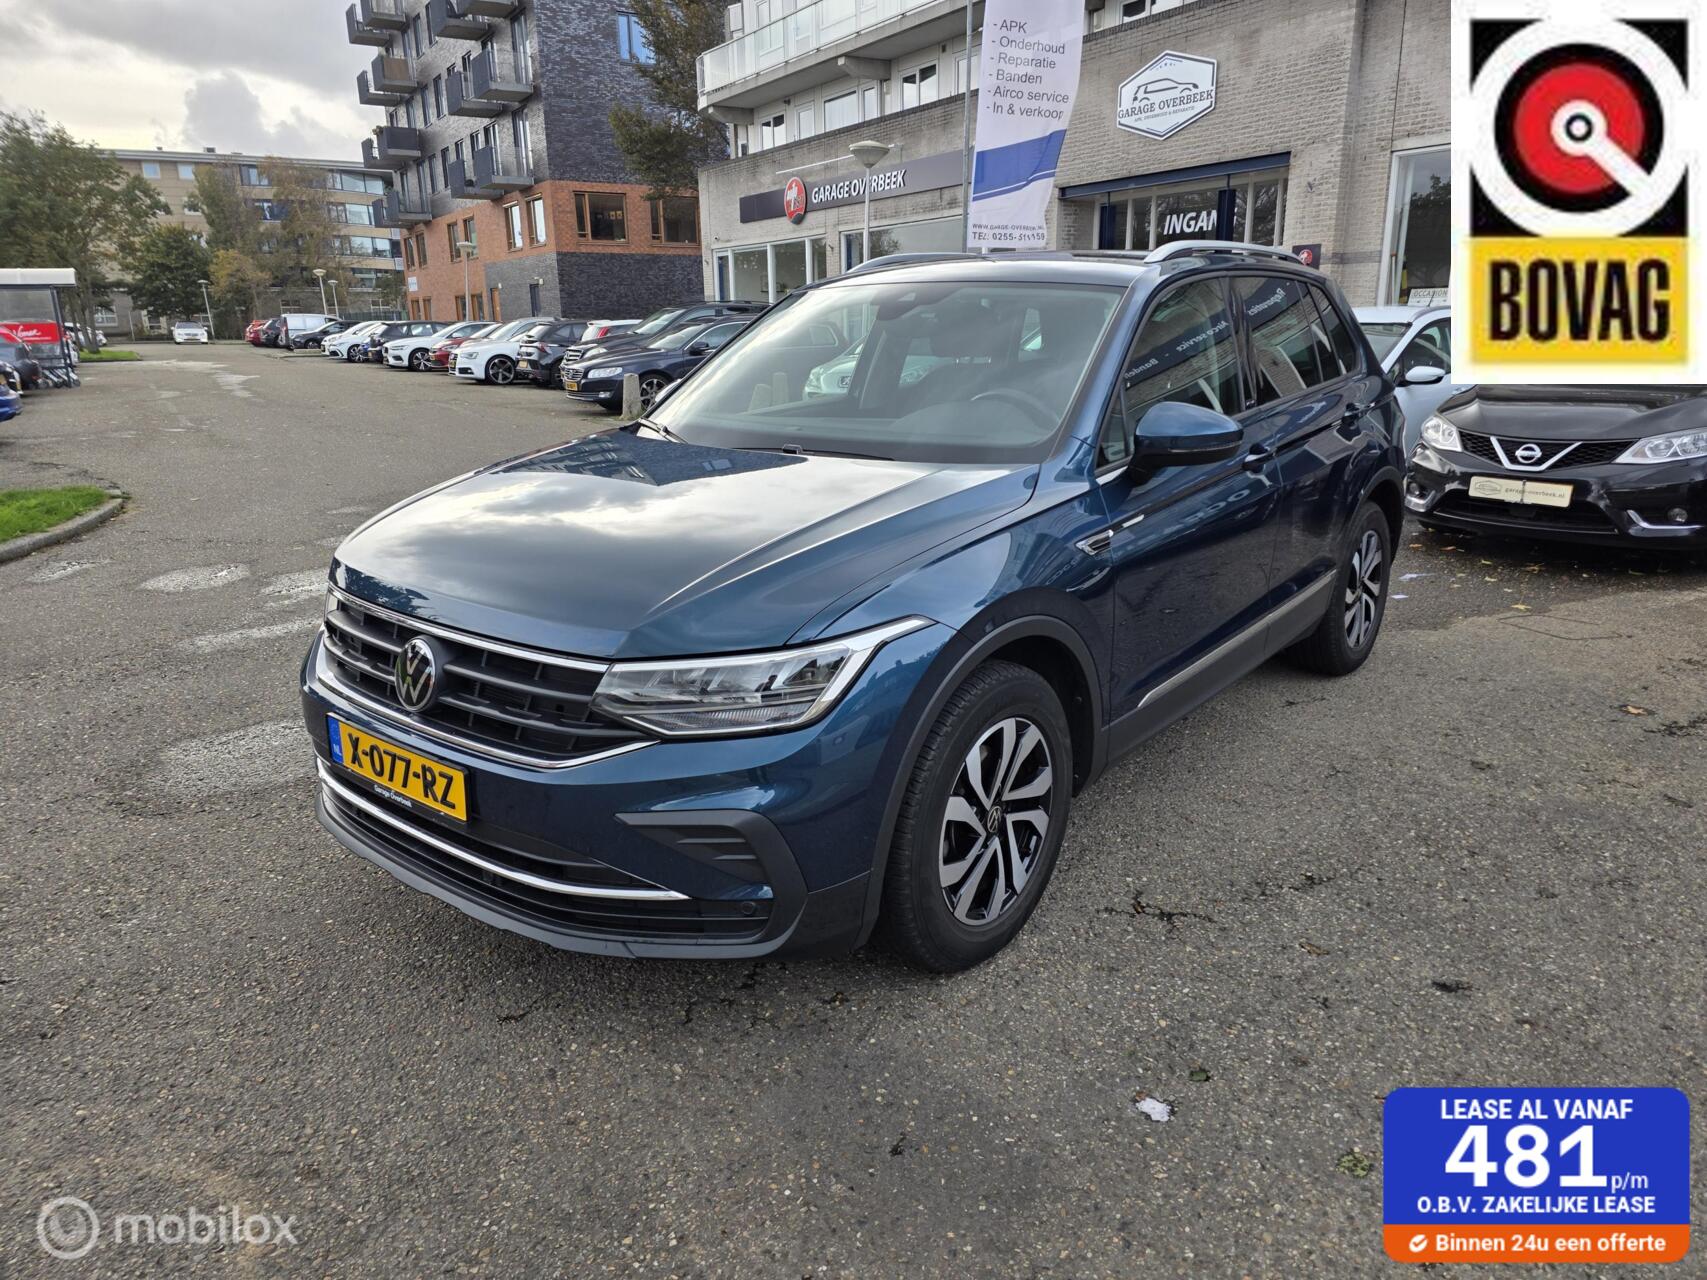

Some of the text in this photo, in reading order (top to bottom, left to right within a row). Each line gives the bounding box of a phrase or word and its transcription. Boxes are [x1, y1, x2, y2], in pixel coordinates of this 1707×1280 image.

[1000, 19, 1027, 34] APK
[1000, 36, 1065, 54] Onderhoud
[998, 52, 1056, 69] Reparatie
[996, 69, 1042, 84] Banden
[993, 86, 1069, 103] Airco service
[993, 101, 1003, 114] In
[1007, 103, 1015, 115] &
[1118, 89, 1214, 119] GARAGE OVERBEEK
[812, 170, 906, 203] GARAGE OVRBEEK
[1163, 207, 1238, 235] INGAN
[348, 733, 456, 809] X-077-RZ
